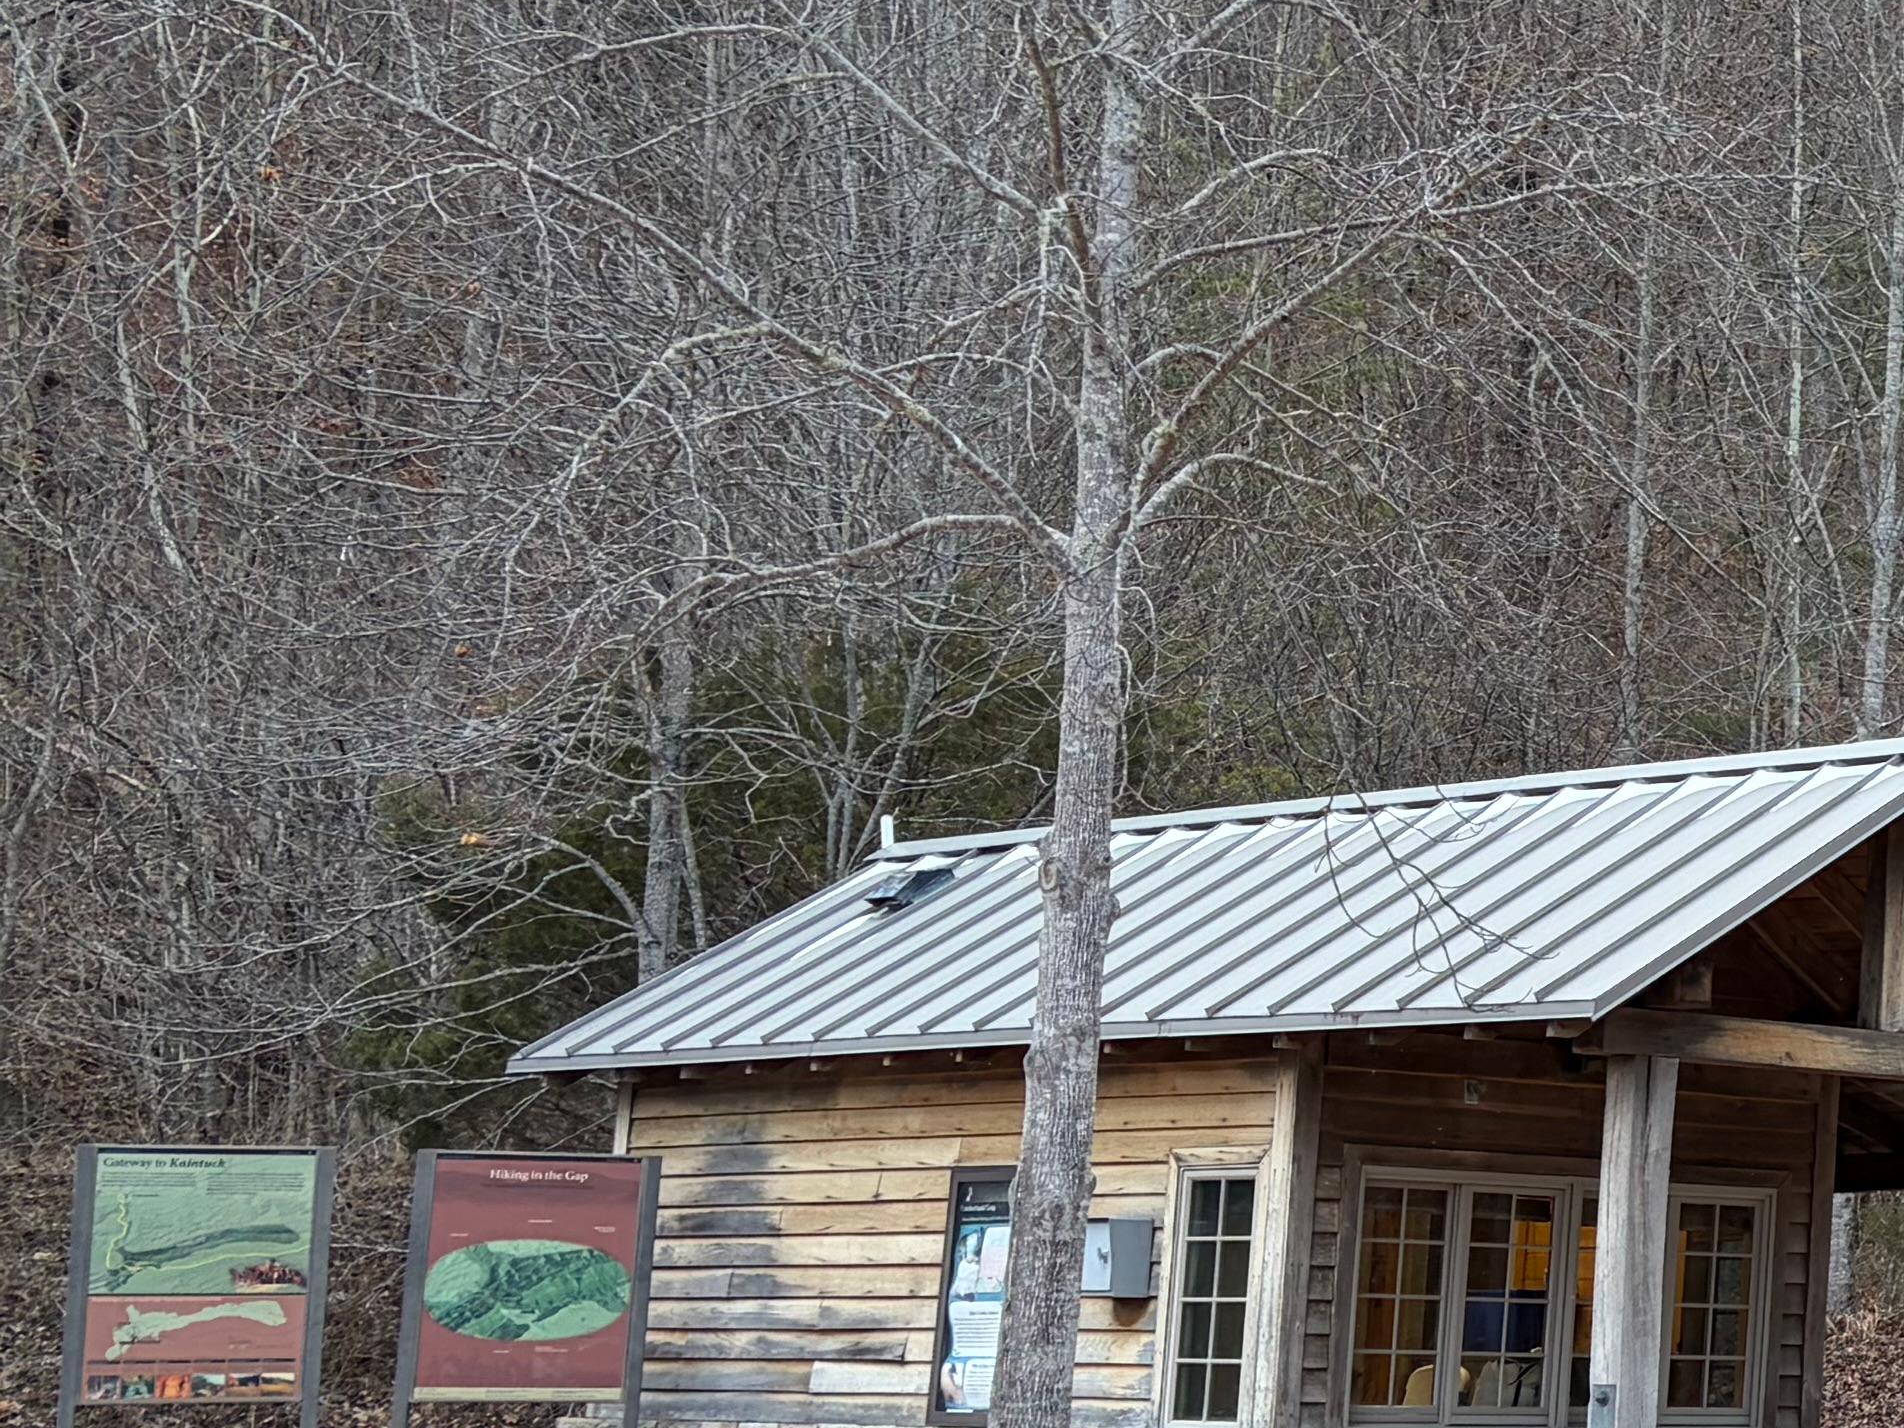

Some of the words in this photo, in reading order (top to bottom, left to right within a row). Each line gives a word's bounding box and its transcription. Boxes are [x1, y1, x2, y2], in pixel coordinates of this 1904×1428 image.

[103, 1157, 152, 1170] Gateway
[155, 1158, 166, 1168] to
[169, 1158, 226, 1169] Kaintuck
[490, 1169, 529, 1182] Hiking
[531, 1170, 542, 1180] in
[545, 1170, 563, 1181] the
[565, 1171, 588, 1183] Gap
